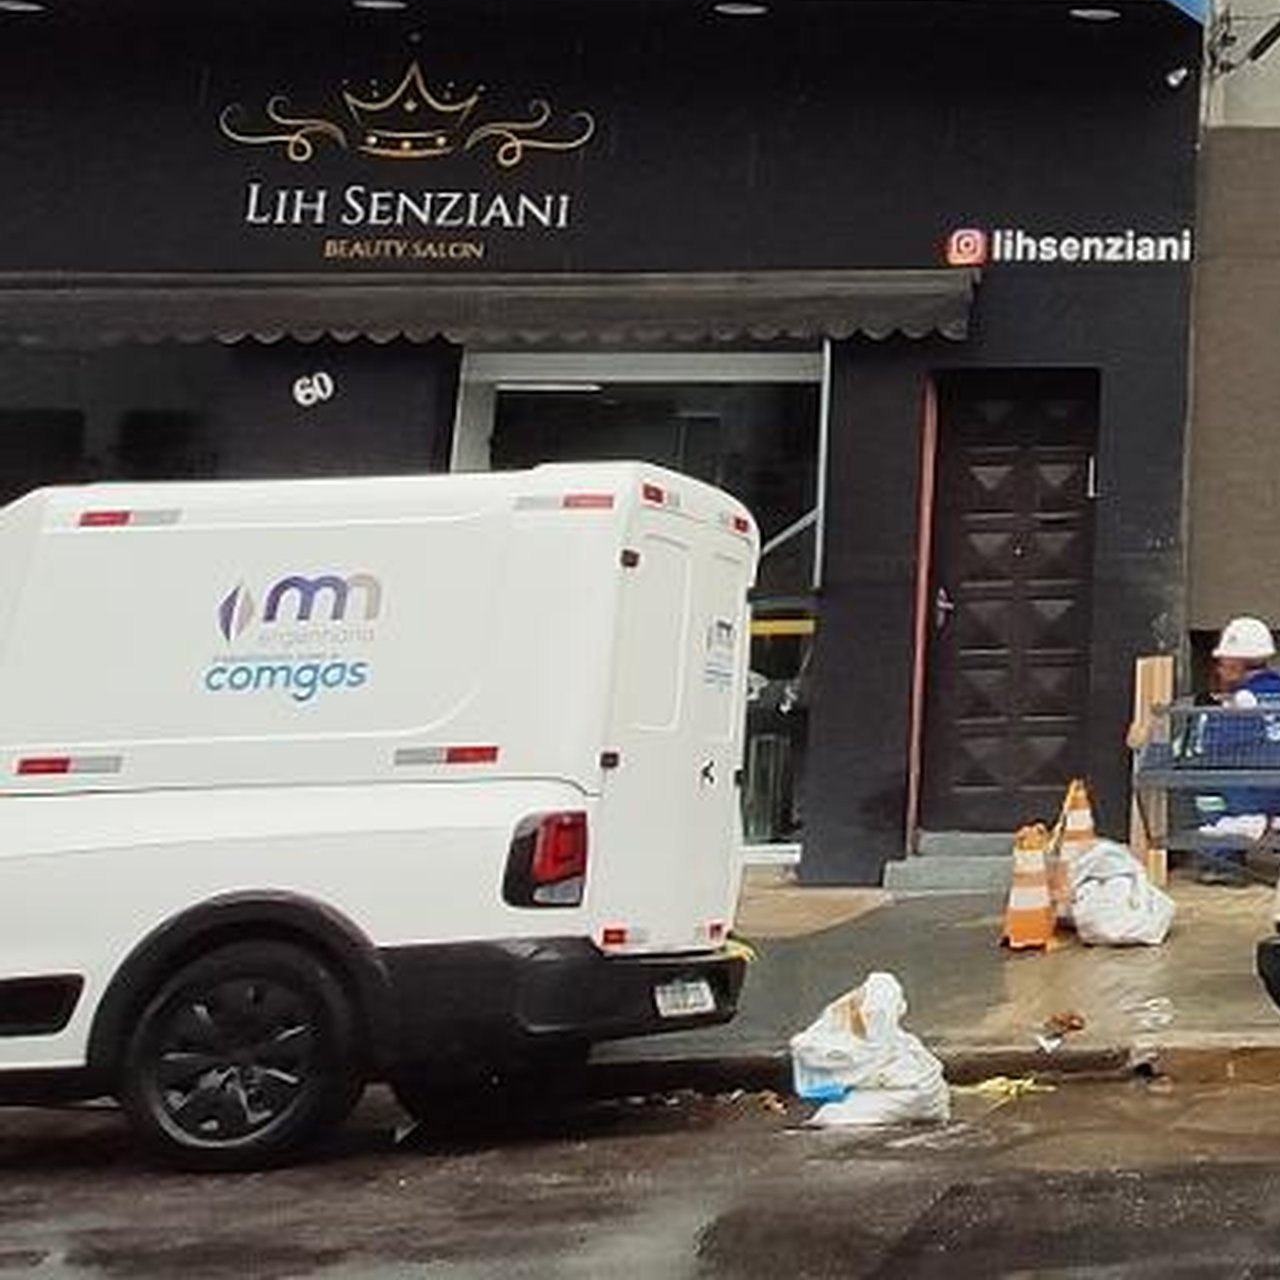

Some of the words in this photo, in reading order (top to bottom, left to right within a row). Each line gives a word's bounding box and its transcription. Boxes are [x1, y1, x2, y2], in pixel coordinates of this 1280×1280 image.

[341, 185, 570, 228] SENZIANI
[324, 238, 408, 259] BEAUTY
[410, 240, 485, 260] SALON
[991, 229, 1192, 262] lihsenziani
[292, 371, 335, 408] 60
